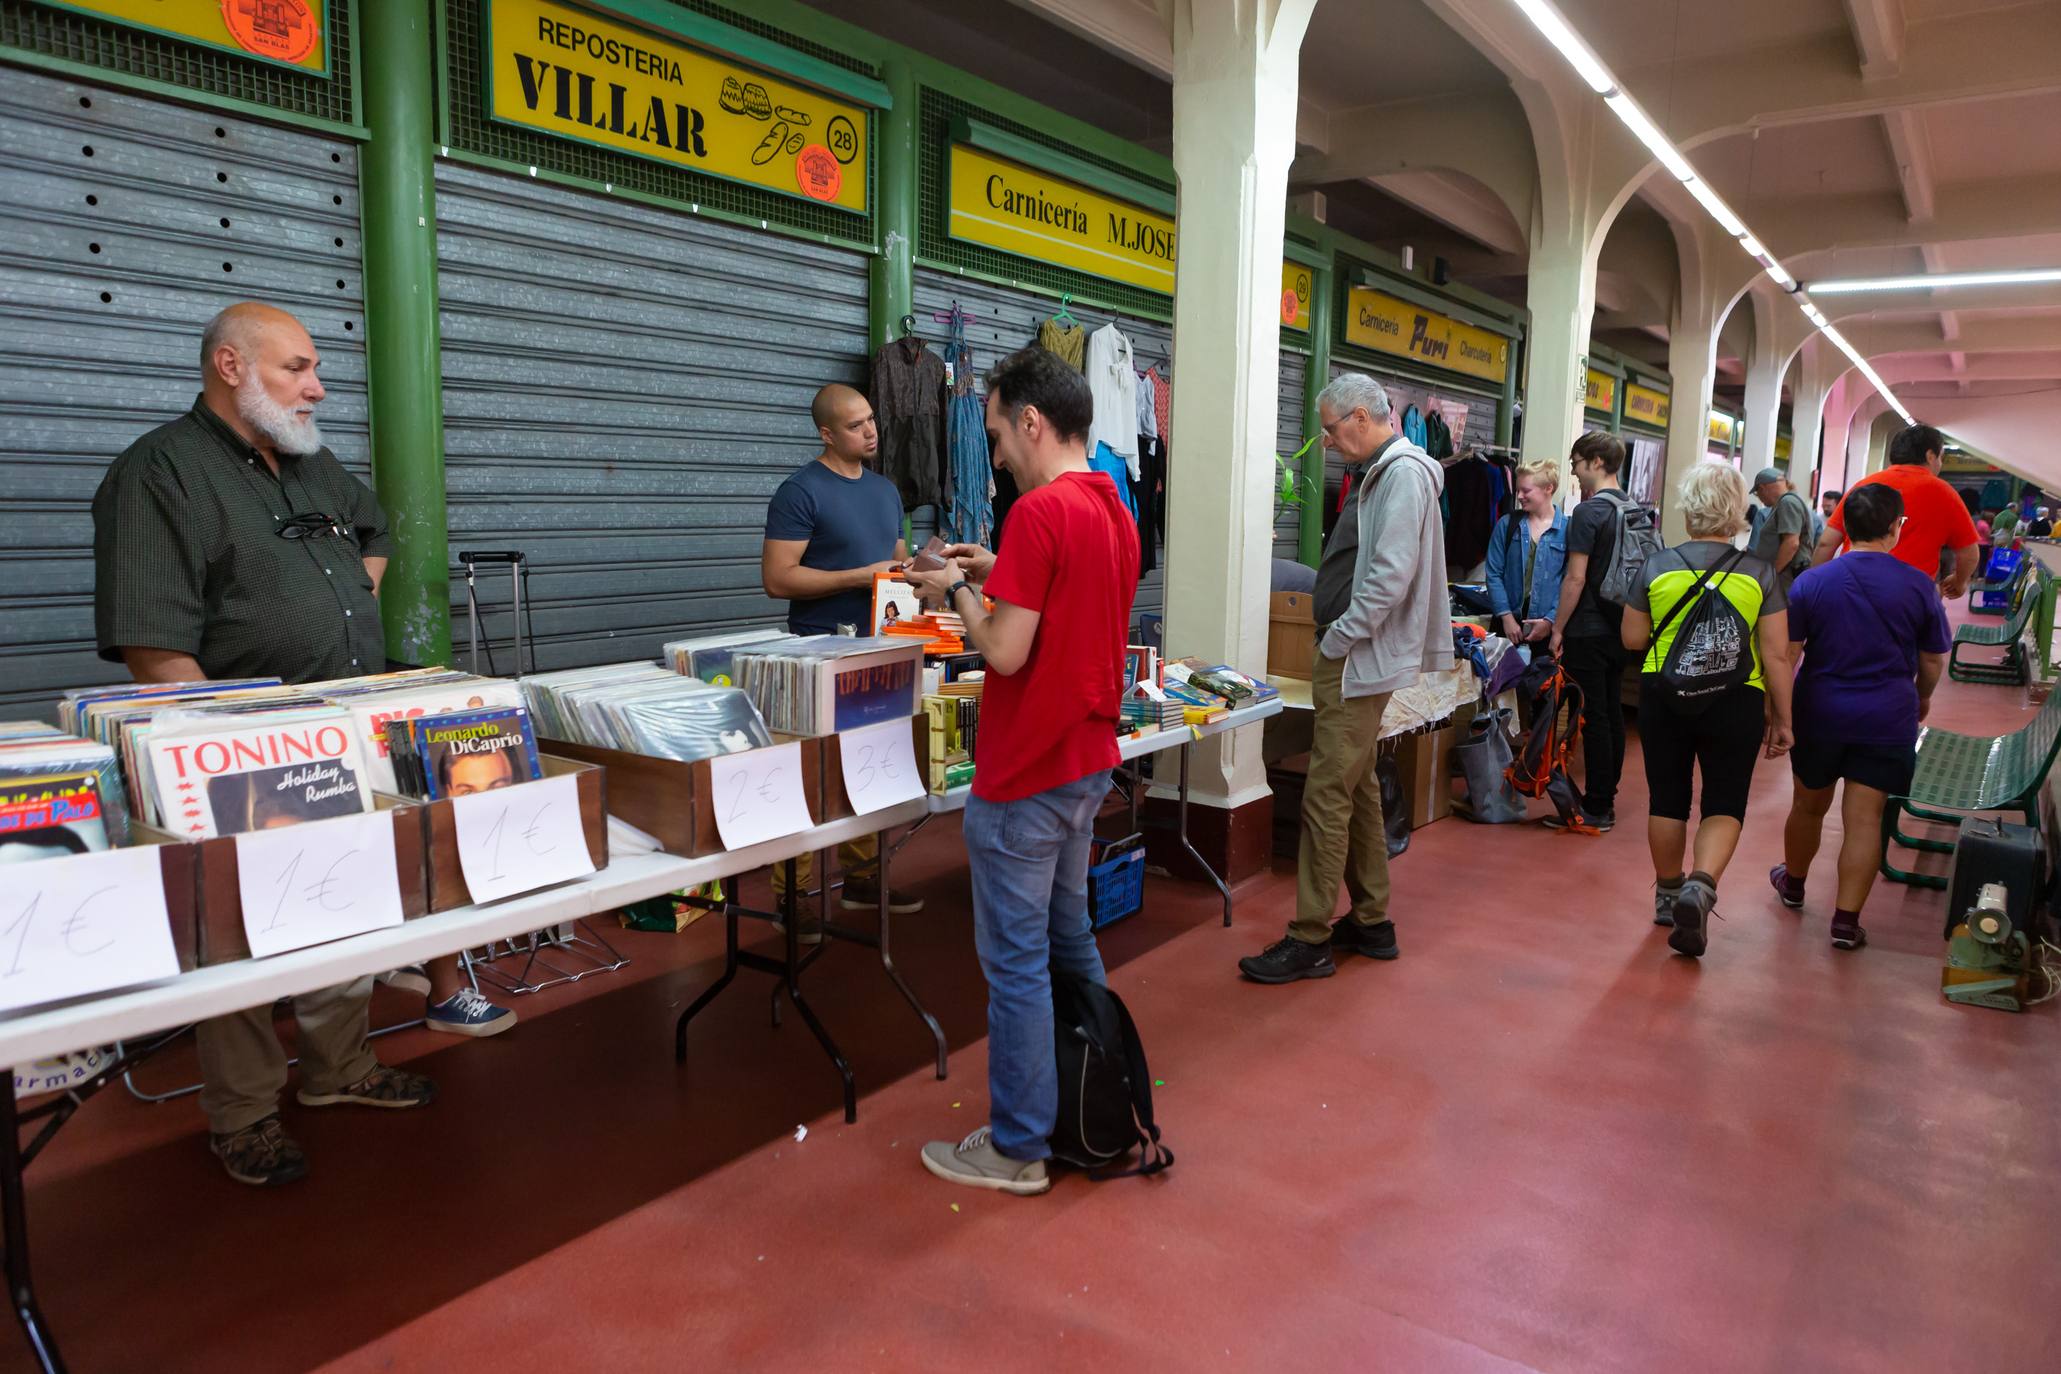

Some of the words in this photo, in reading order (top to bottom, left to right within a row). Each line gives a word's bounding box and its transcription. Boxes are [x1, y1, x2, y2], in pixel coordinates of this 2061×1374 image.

[538, 16, 684, 86] REPOSTERIA
[513, 52, 708, 158] VILLAR
[833, 129, 853, 151] 28
[985, 173, 1088, 235] Carnicería
[425, 721, 500, 744] Leonardo
[450, 731, 524, 756] DiCaprio
[163, 726, 348, 778] TONINO
[277, 763, 340, 791] Holiday
[305, 776, 357, 803] Rumba
